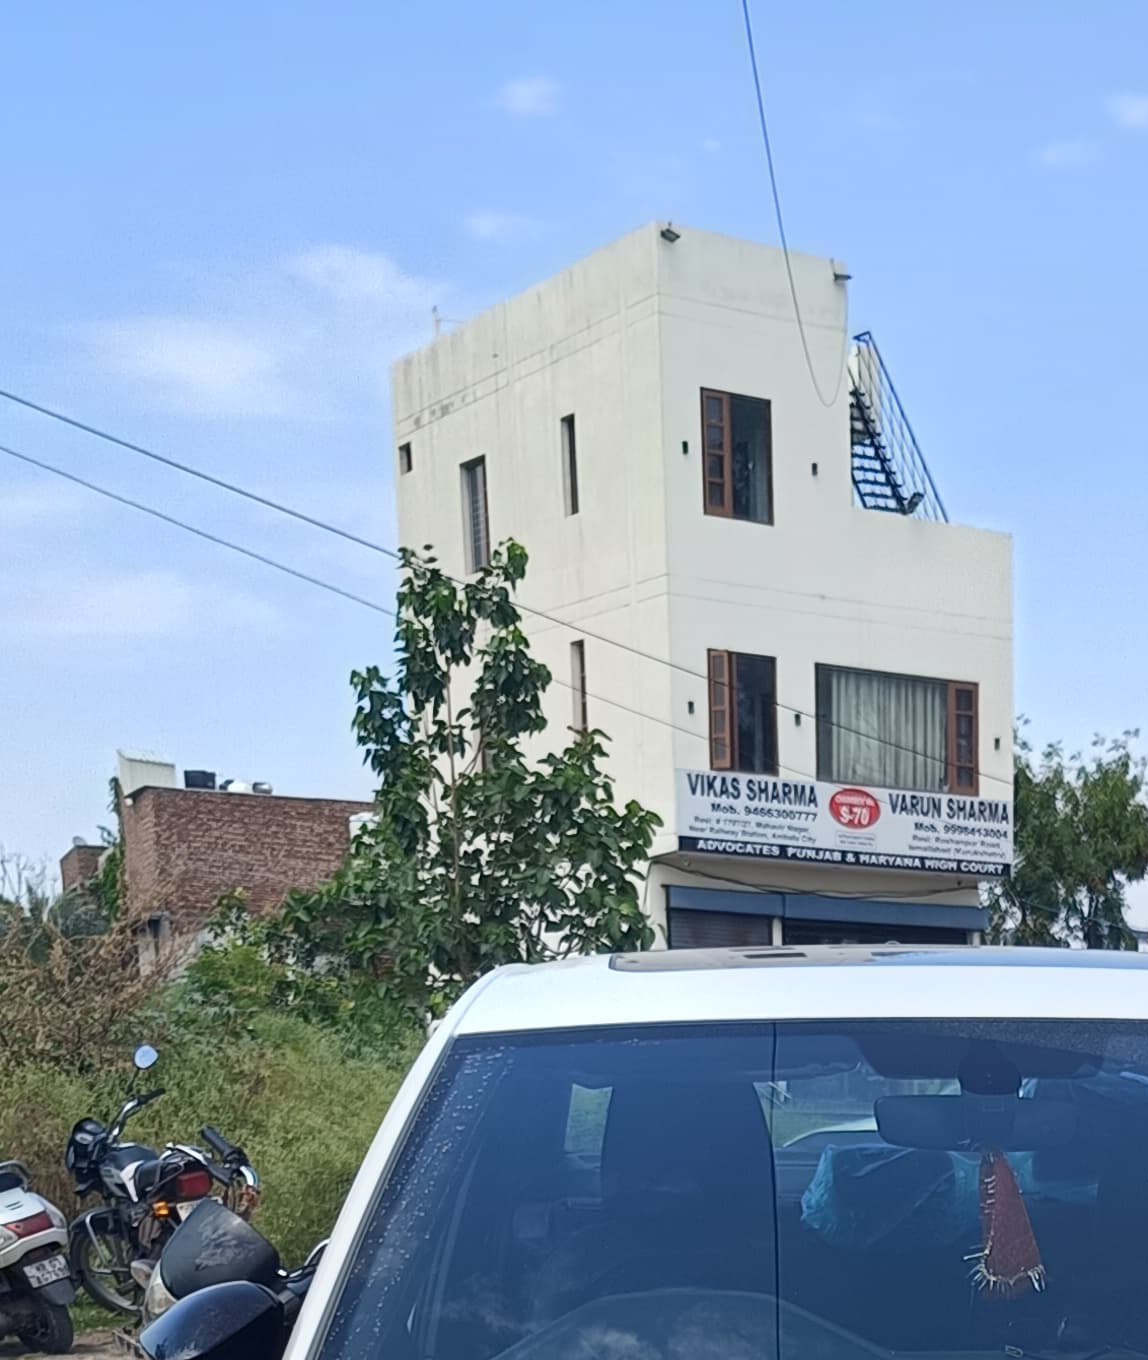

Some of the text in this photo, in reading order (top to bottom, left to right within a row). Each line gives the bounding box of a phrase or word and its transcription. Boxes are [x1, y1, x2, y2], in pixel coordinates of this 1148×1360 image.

[687, 773, 741, 800] VIKAS
[746, 779, 818, 808] SHARMA
[711, 803, 740, 815] Mob.
[888, 793, 942, 819] VARUN
[946, 798, 1009, 825] SHARMA
[914, 822, 940, 834] Mob.
[697, 840, 1004, 875] ADVOCATES PUNJAB & HARYANA HIGH COURT
